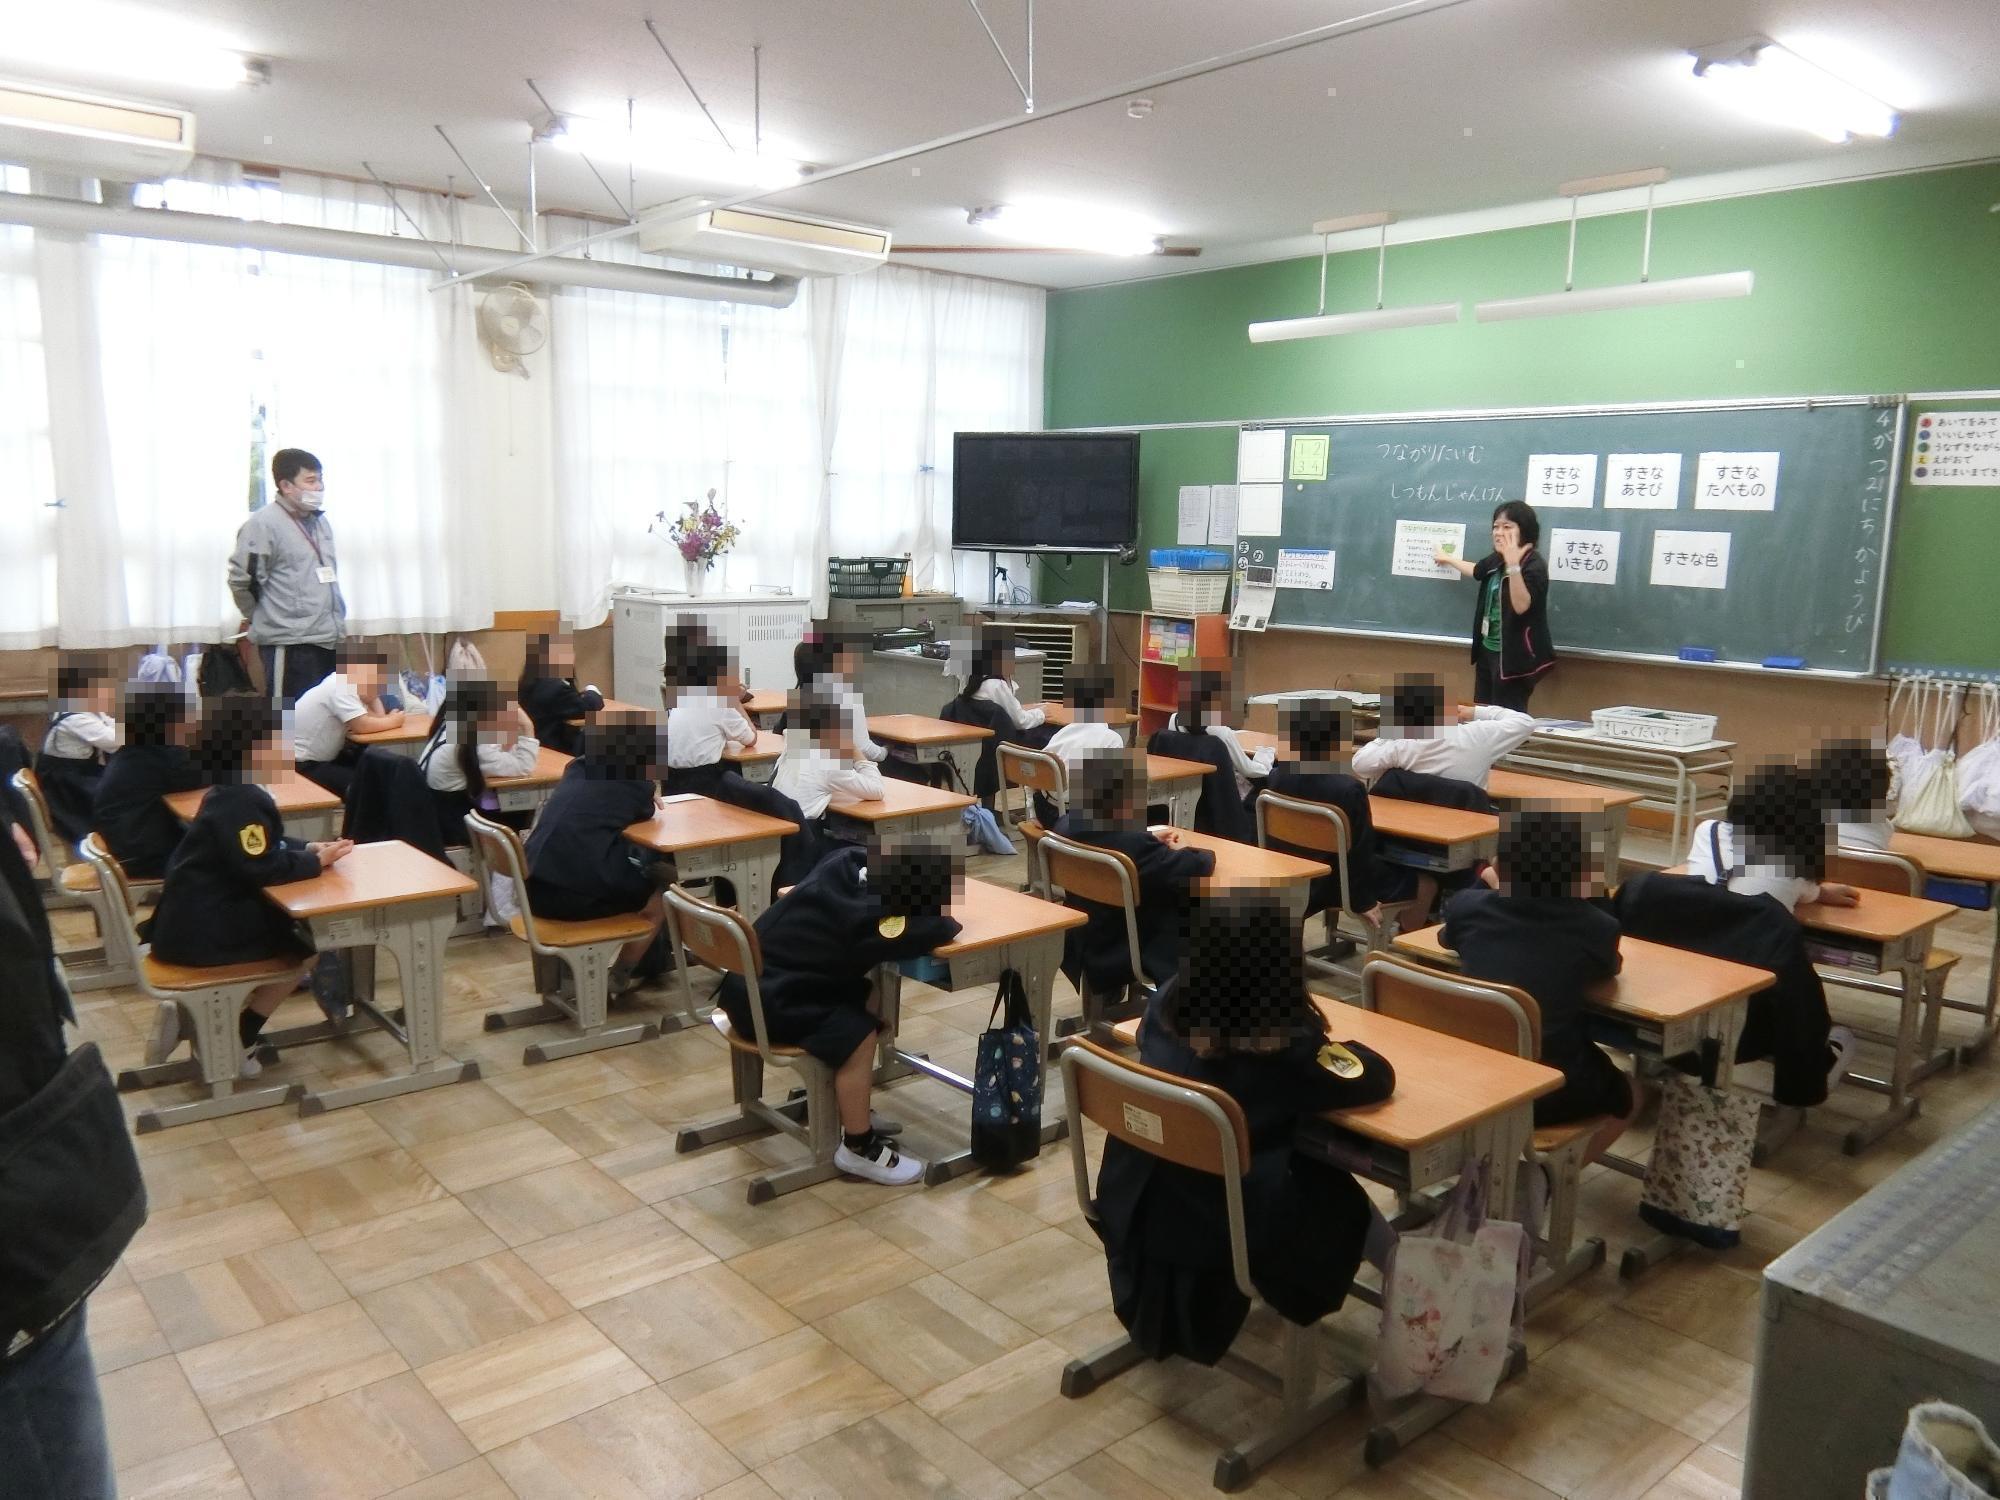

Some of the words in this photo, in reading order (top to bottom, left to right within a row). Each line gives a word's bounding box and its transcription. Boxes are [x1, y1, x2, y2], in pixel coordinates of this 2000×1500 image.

[1376, 443, 1485, 464] つながりたいむ
[1543, 466, 1582, 480] すきな
[1624, 466, 1664, 480] すきな
[1716, 465, 1760, 480] すきな
[1541, 482, 1580, 496] きせつ
[1621, 482, 1664, 497] あそび
[1706, 483, 1766, 497] たべもの
[1565, 541, 1604, 556] すきな
[1556, 556, 1609, 572] いきもの
[1663, 551, 1719, 568] すきな色
